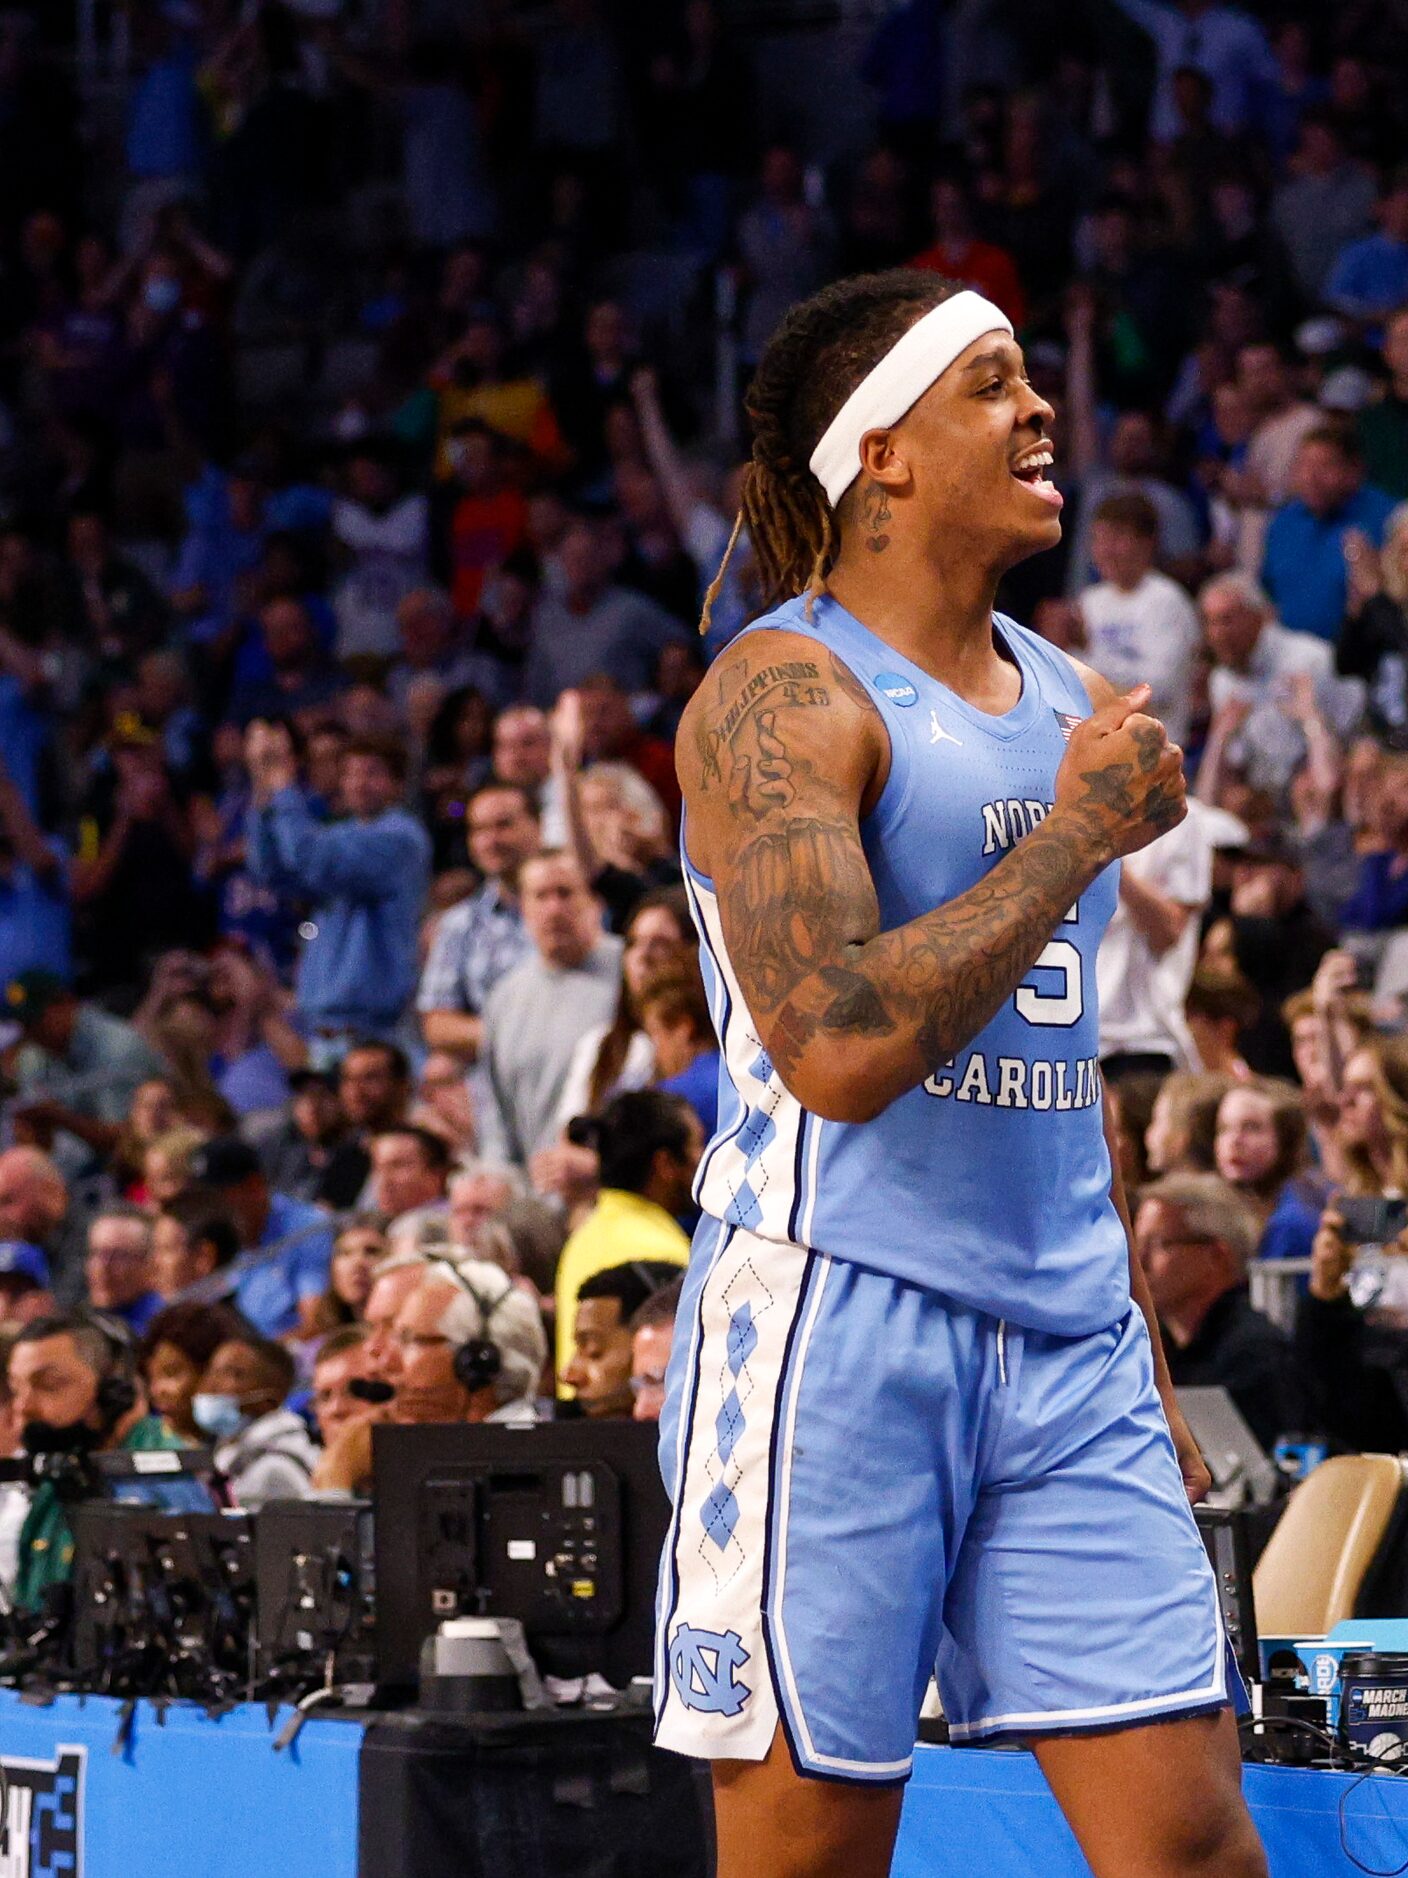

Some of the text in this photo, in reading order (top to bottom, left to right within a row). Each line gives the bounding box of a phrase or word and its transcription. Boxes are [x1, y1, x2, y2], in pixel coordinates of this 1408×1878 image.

[981, 798, 1055, 857] NOR
[923, 1052, 1100, 1111] CAROLIN
[1362, 1689, 1407, 1704] MARCH
